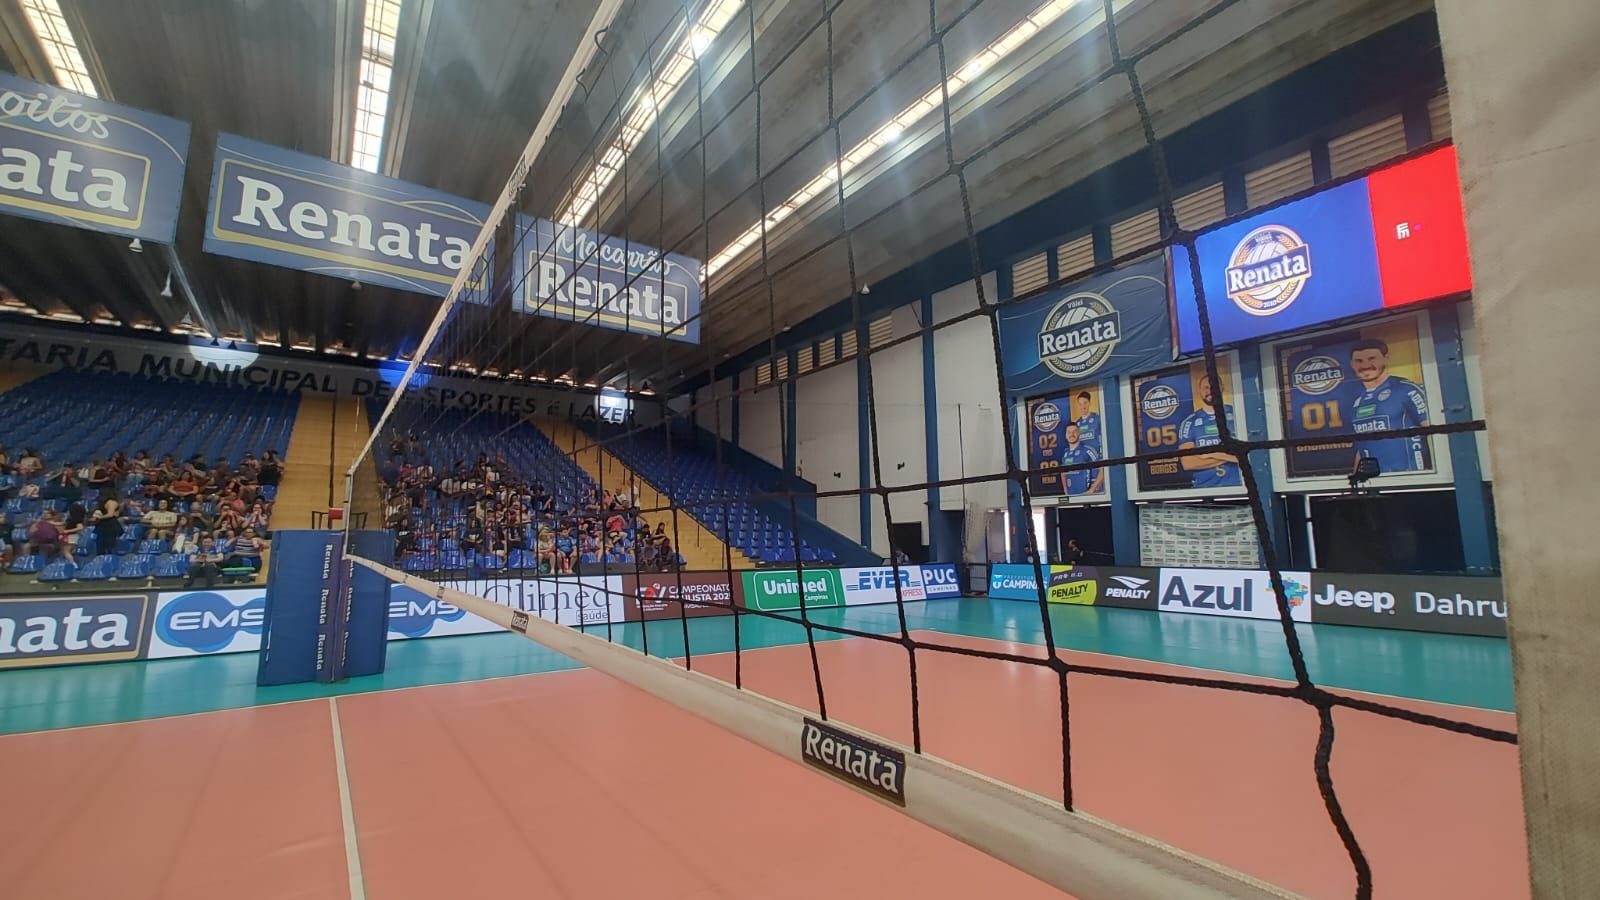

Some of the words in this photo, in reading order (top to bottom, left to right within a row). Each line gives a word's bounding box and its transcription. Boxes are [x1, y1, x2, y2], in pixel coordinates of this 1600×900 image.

[0, 147, 129, 212] ata
[232, 175, 471, 270] Renata
[552, 229, 674, 276] Macarrão
[1228, 254, 1307, 292] Renata
[536, 259, 681, 324] Renata
[1041, 319, 1118, 356] Renata
[138, 353, 337, 393] MUNICIPAL
[351, 377, 391, 401] DE
[1294, 368, 1342, 385] Renata
[1144, 397, 1178, 410] Renata
[1034, 413, 1060, 423] Renata
[1302, 400, 1343, 431] 01
[1038, 433, 1057, 449] 02
[1147, 424, 1178, 447] 05
[763, 578, 827, 595] Unimed
[858, 569, 910, 590] EVER
[922, 568, 956, 585] PUC
[713, 592, 730, 601] 202
[902, 588, 923, 596] XPRESS
[1051, 583, 1088, 598] PENALTY
[1105, 587, 1151, 599] PENALTY
[1160, 576, 1252, 611] Azul
[1314, 584, 1395, 613] Jeep
[1414, 591, 1508, 618] Dahru
[169, 608, 265, 630] EMS
[388, 600, 459, 617] EMS
[805, 723, 898, 794] Renata
